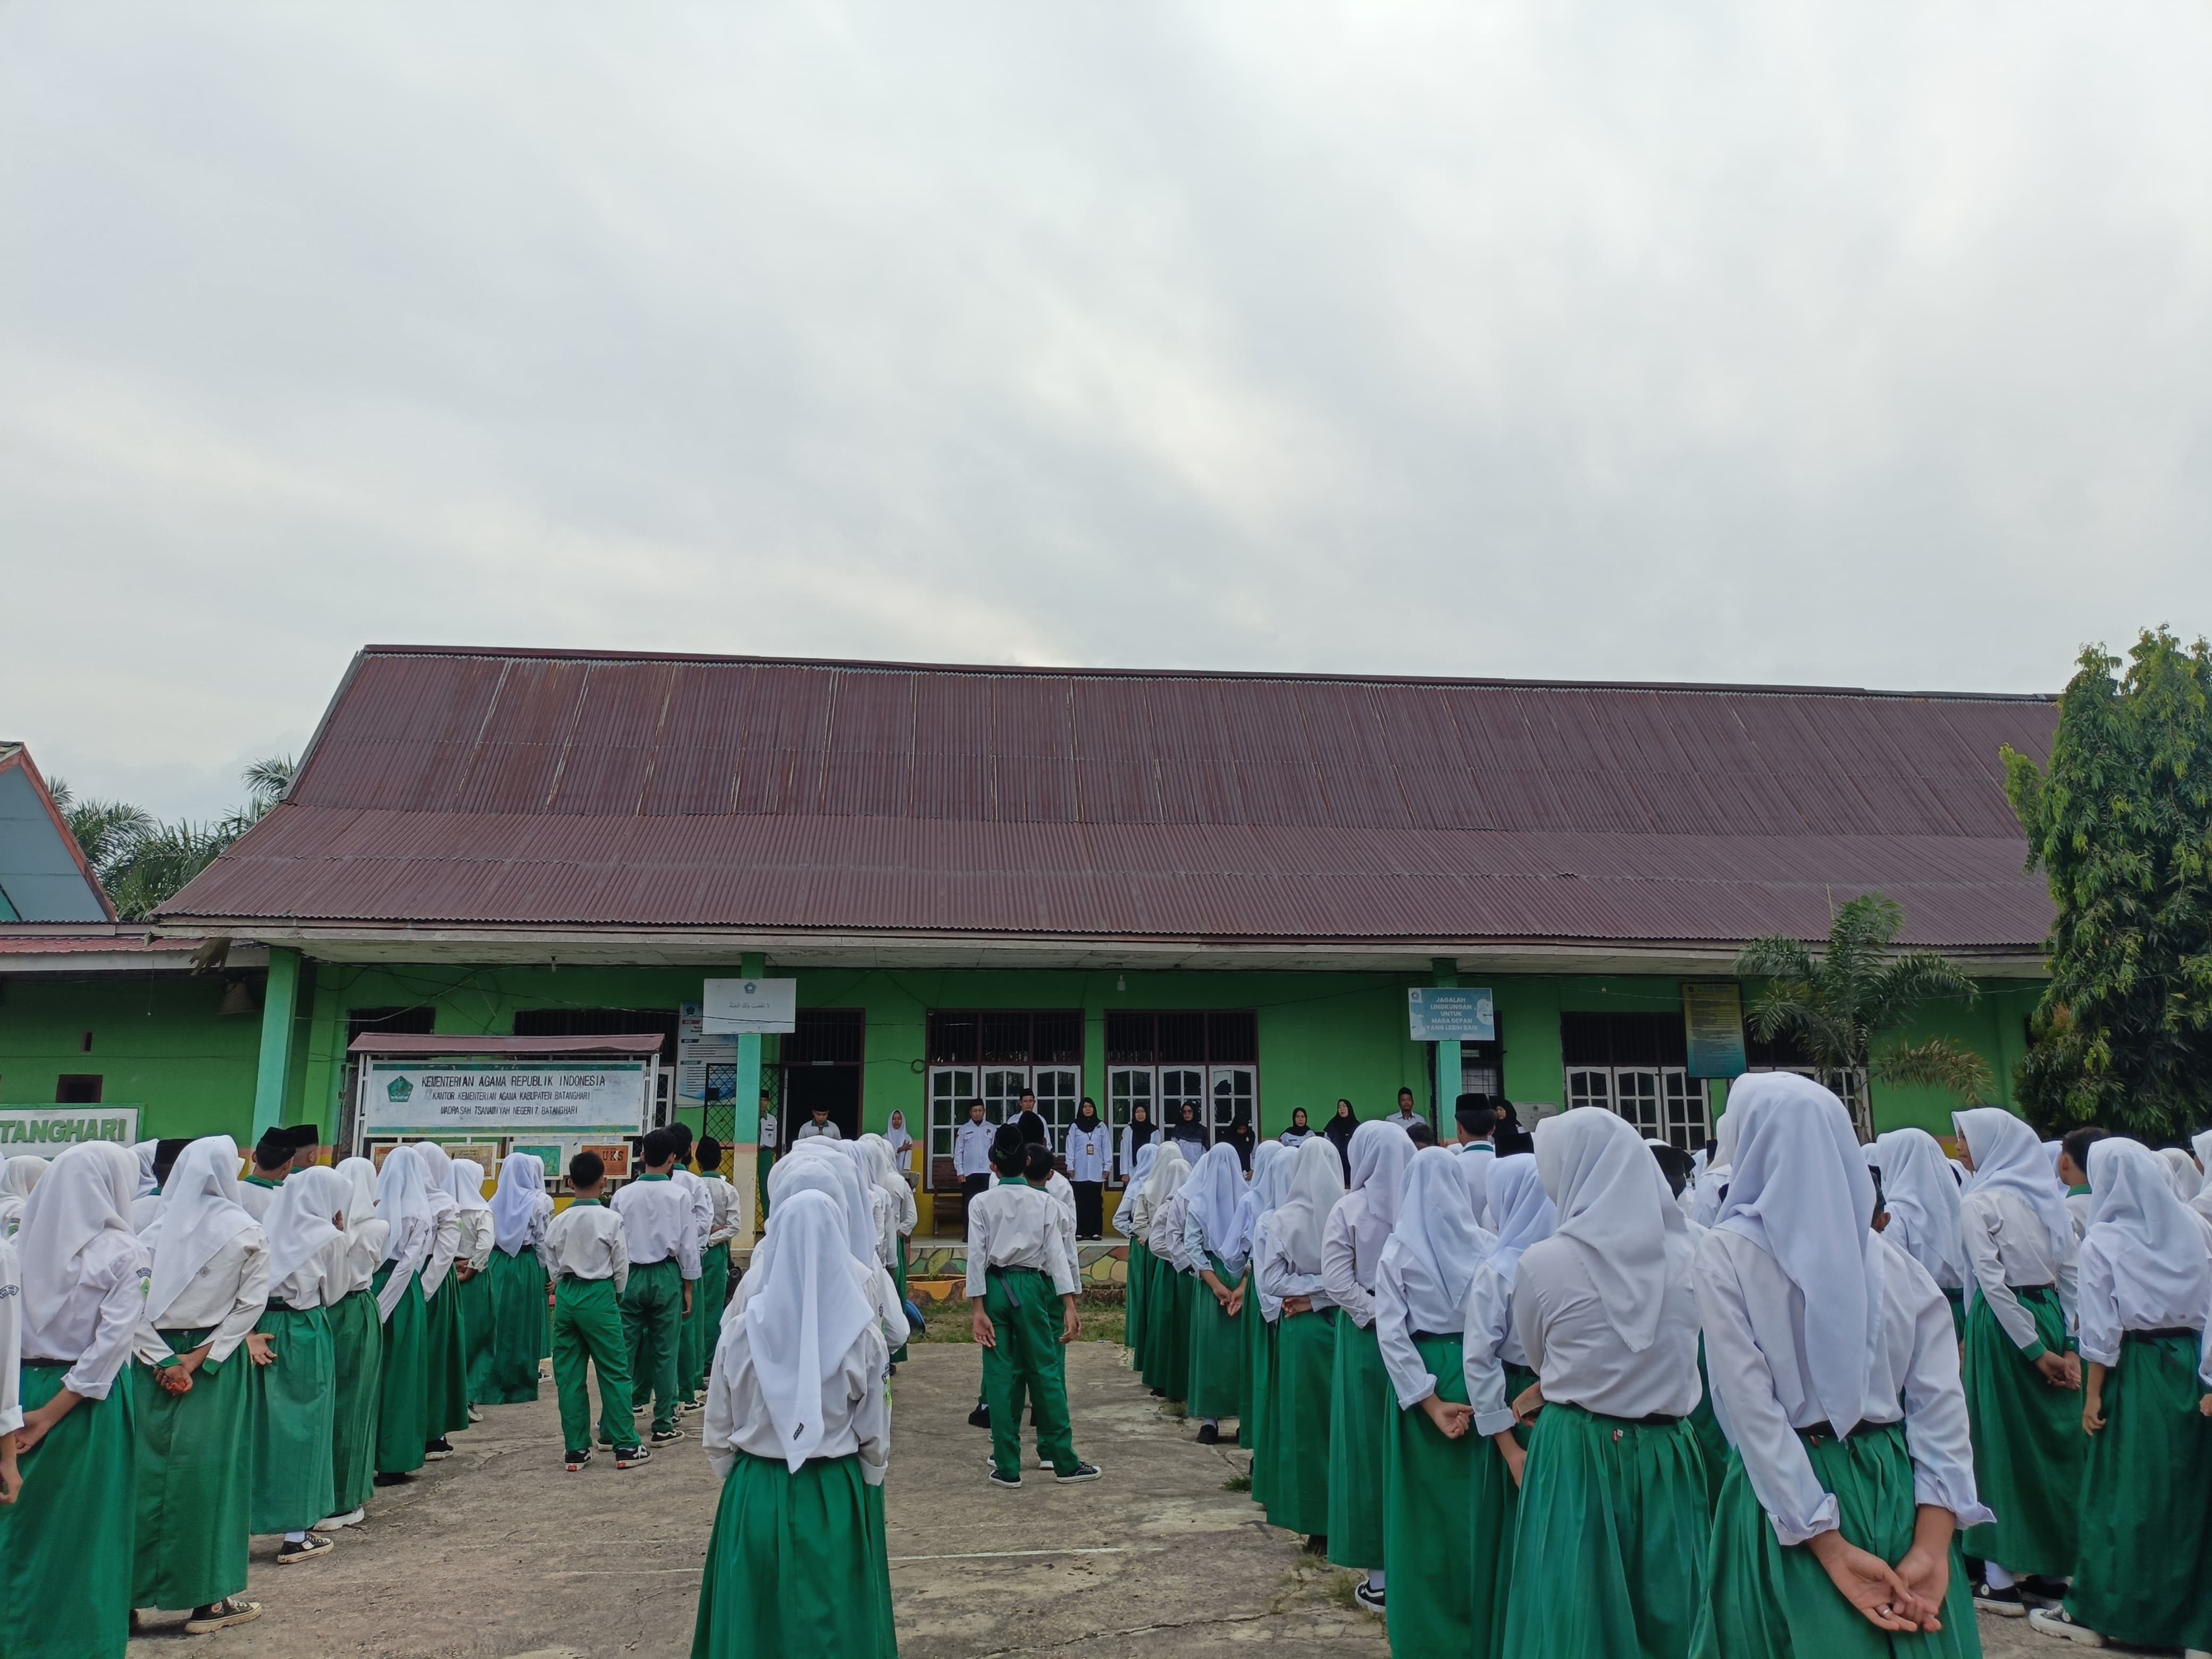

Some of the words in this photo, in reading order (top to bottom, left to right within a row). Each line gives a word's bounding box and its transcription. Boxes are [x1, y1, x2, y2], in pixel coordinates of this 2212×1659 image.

[422, 1076, 474, 1087] KEMENTERIAN
[479, 1076, 506, 1087] AGAMA
[511, 1075, 554, 1086] REPUBLIK
[559, 1075, 605, 1086] INDONESIA
[433, 1092, 455, 1100] KANTOR
[458, 1092, 496, 1101] KEMENTERIAN
[520, 1092, 552, 1100] KABUPATEN
[555, 1091, 590, 1100] BATANGHARI
[441, 1106, 471, 1115] MADRASAH
[474, 1106, 510, 1115] TSANAWIYAH
[541, 1106, 578, 1115] BATANGHARI
[602, 1150, 624, 1161] UKS
